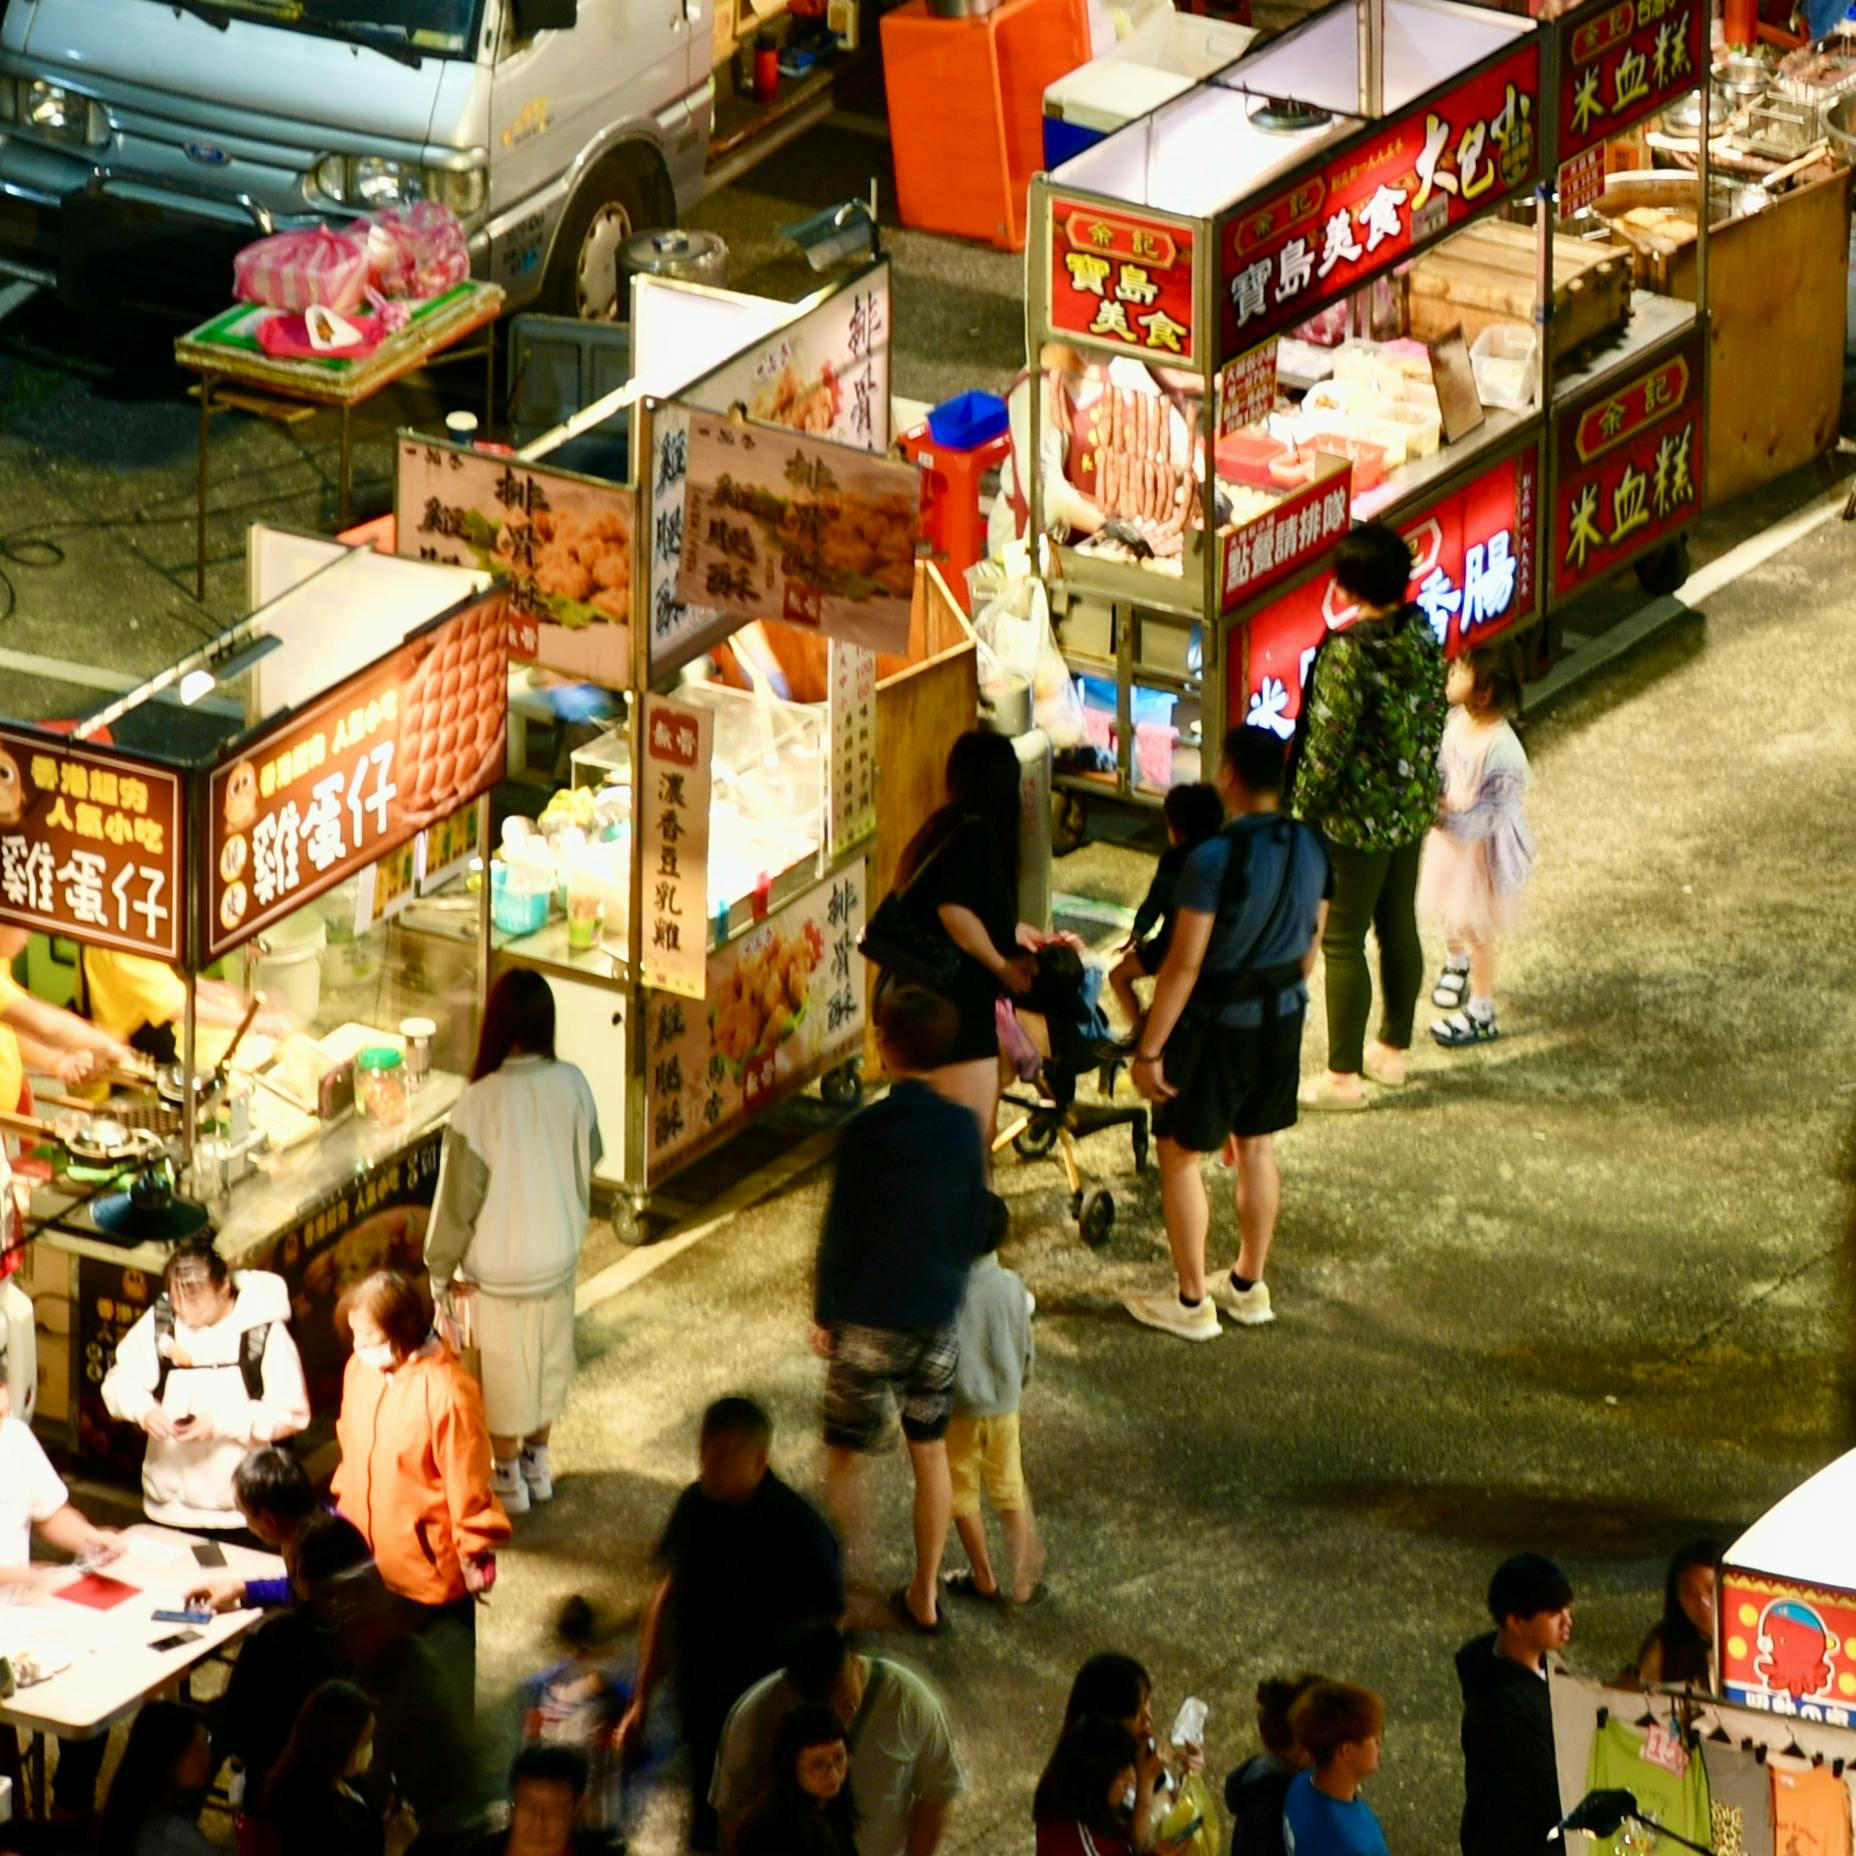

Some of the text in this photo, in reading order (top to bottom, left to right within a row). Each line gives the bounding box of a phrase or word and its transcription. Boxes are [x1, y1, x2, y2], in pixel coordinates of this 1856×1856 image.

[1569, 9, 1692, 137] 米血糕
[1064, 251, 1161, 307] 寶島
[1231, 183, 1409, 329] 寶島美食
[1089, 298, 1189, 353] 美食
[1564, 421, 1695, 570] 米血糕
[1416, 528, 1518, 646] 香腸
[45, 796, 164, 855] 人氣小吃
[252, 740, 398, 906] 雞蛋仔
[651, 770, 690, 954] 濃香豆乳雞
[2, 834, 169, 940] 雞蛋仔
